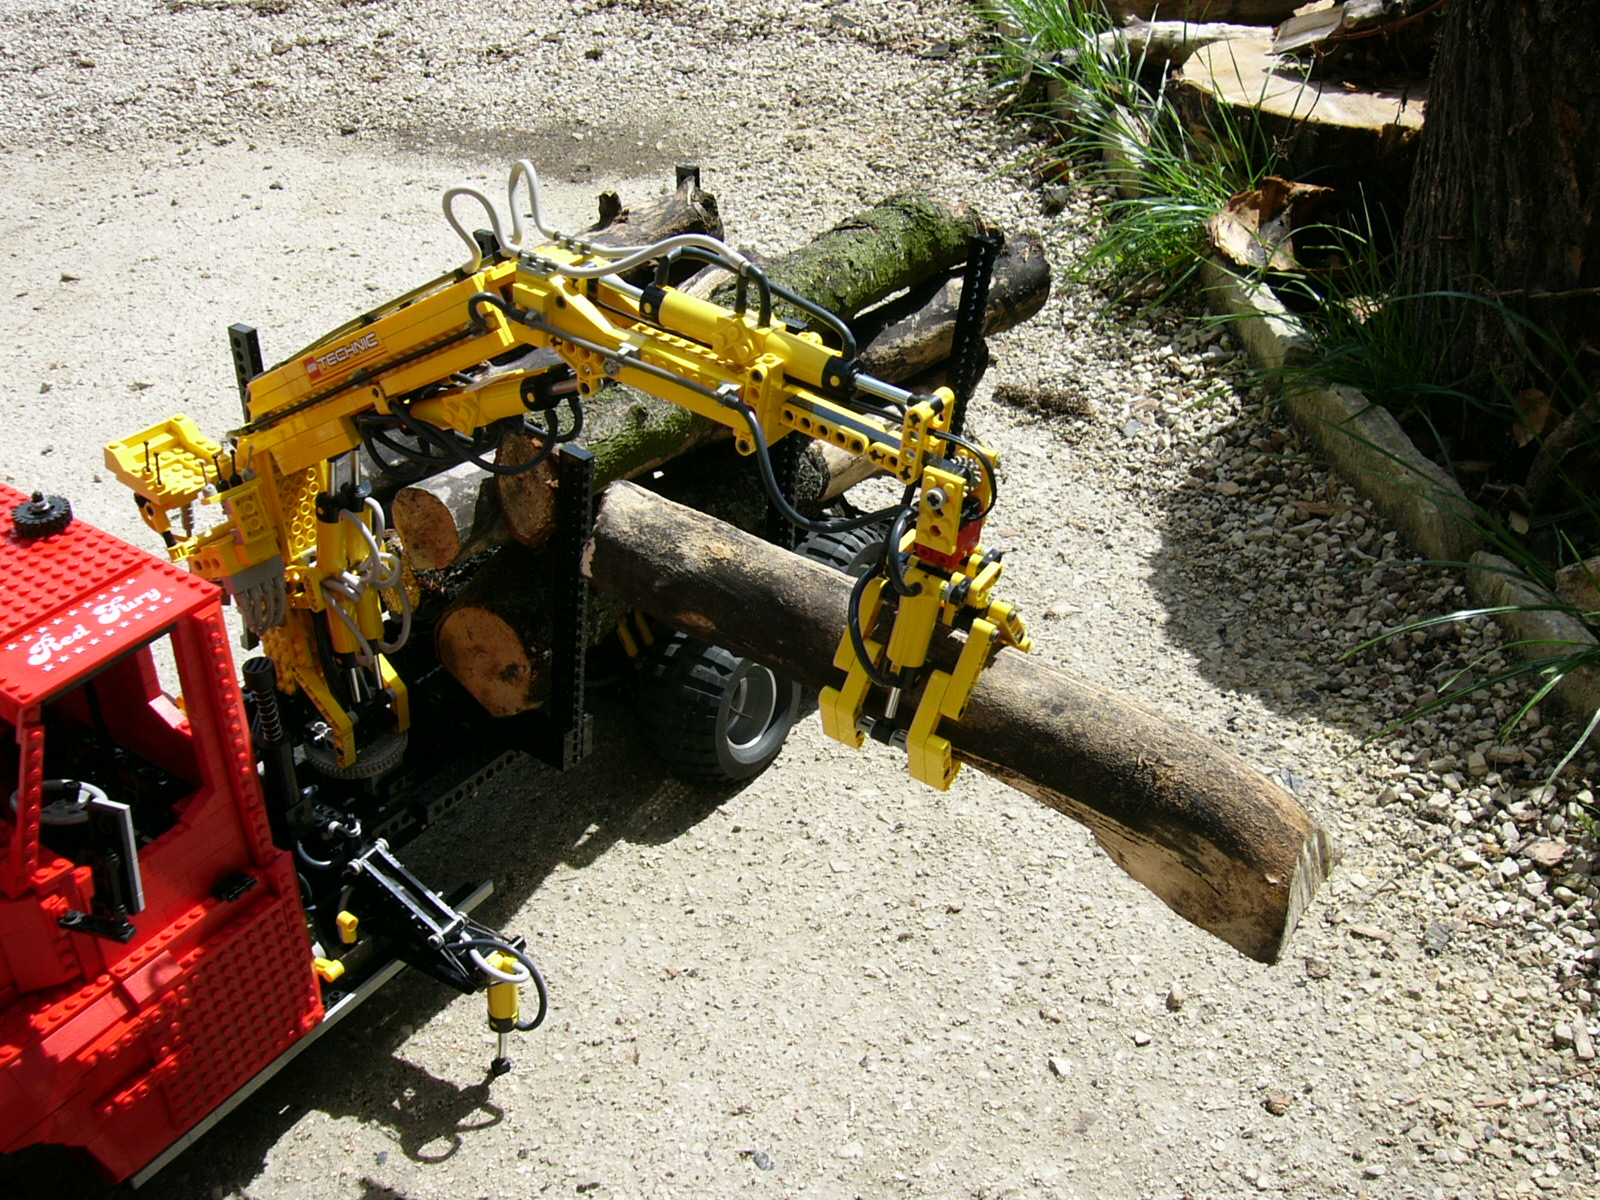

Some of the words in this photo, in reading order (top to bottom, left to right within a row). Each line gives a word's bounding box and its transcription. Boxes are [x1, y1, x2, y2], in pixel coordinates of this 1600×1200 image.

[317, 332, 379, 369] TECHNIC
[27, 624, 91, 666] Red
[92, 588, 162, 625] Fury
